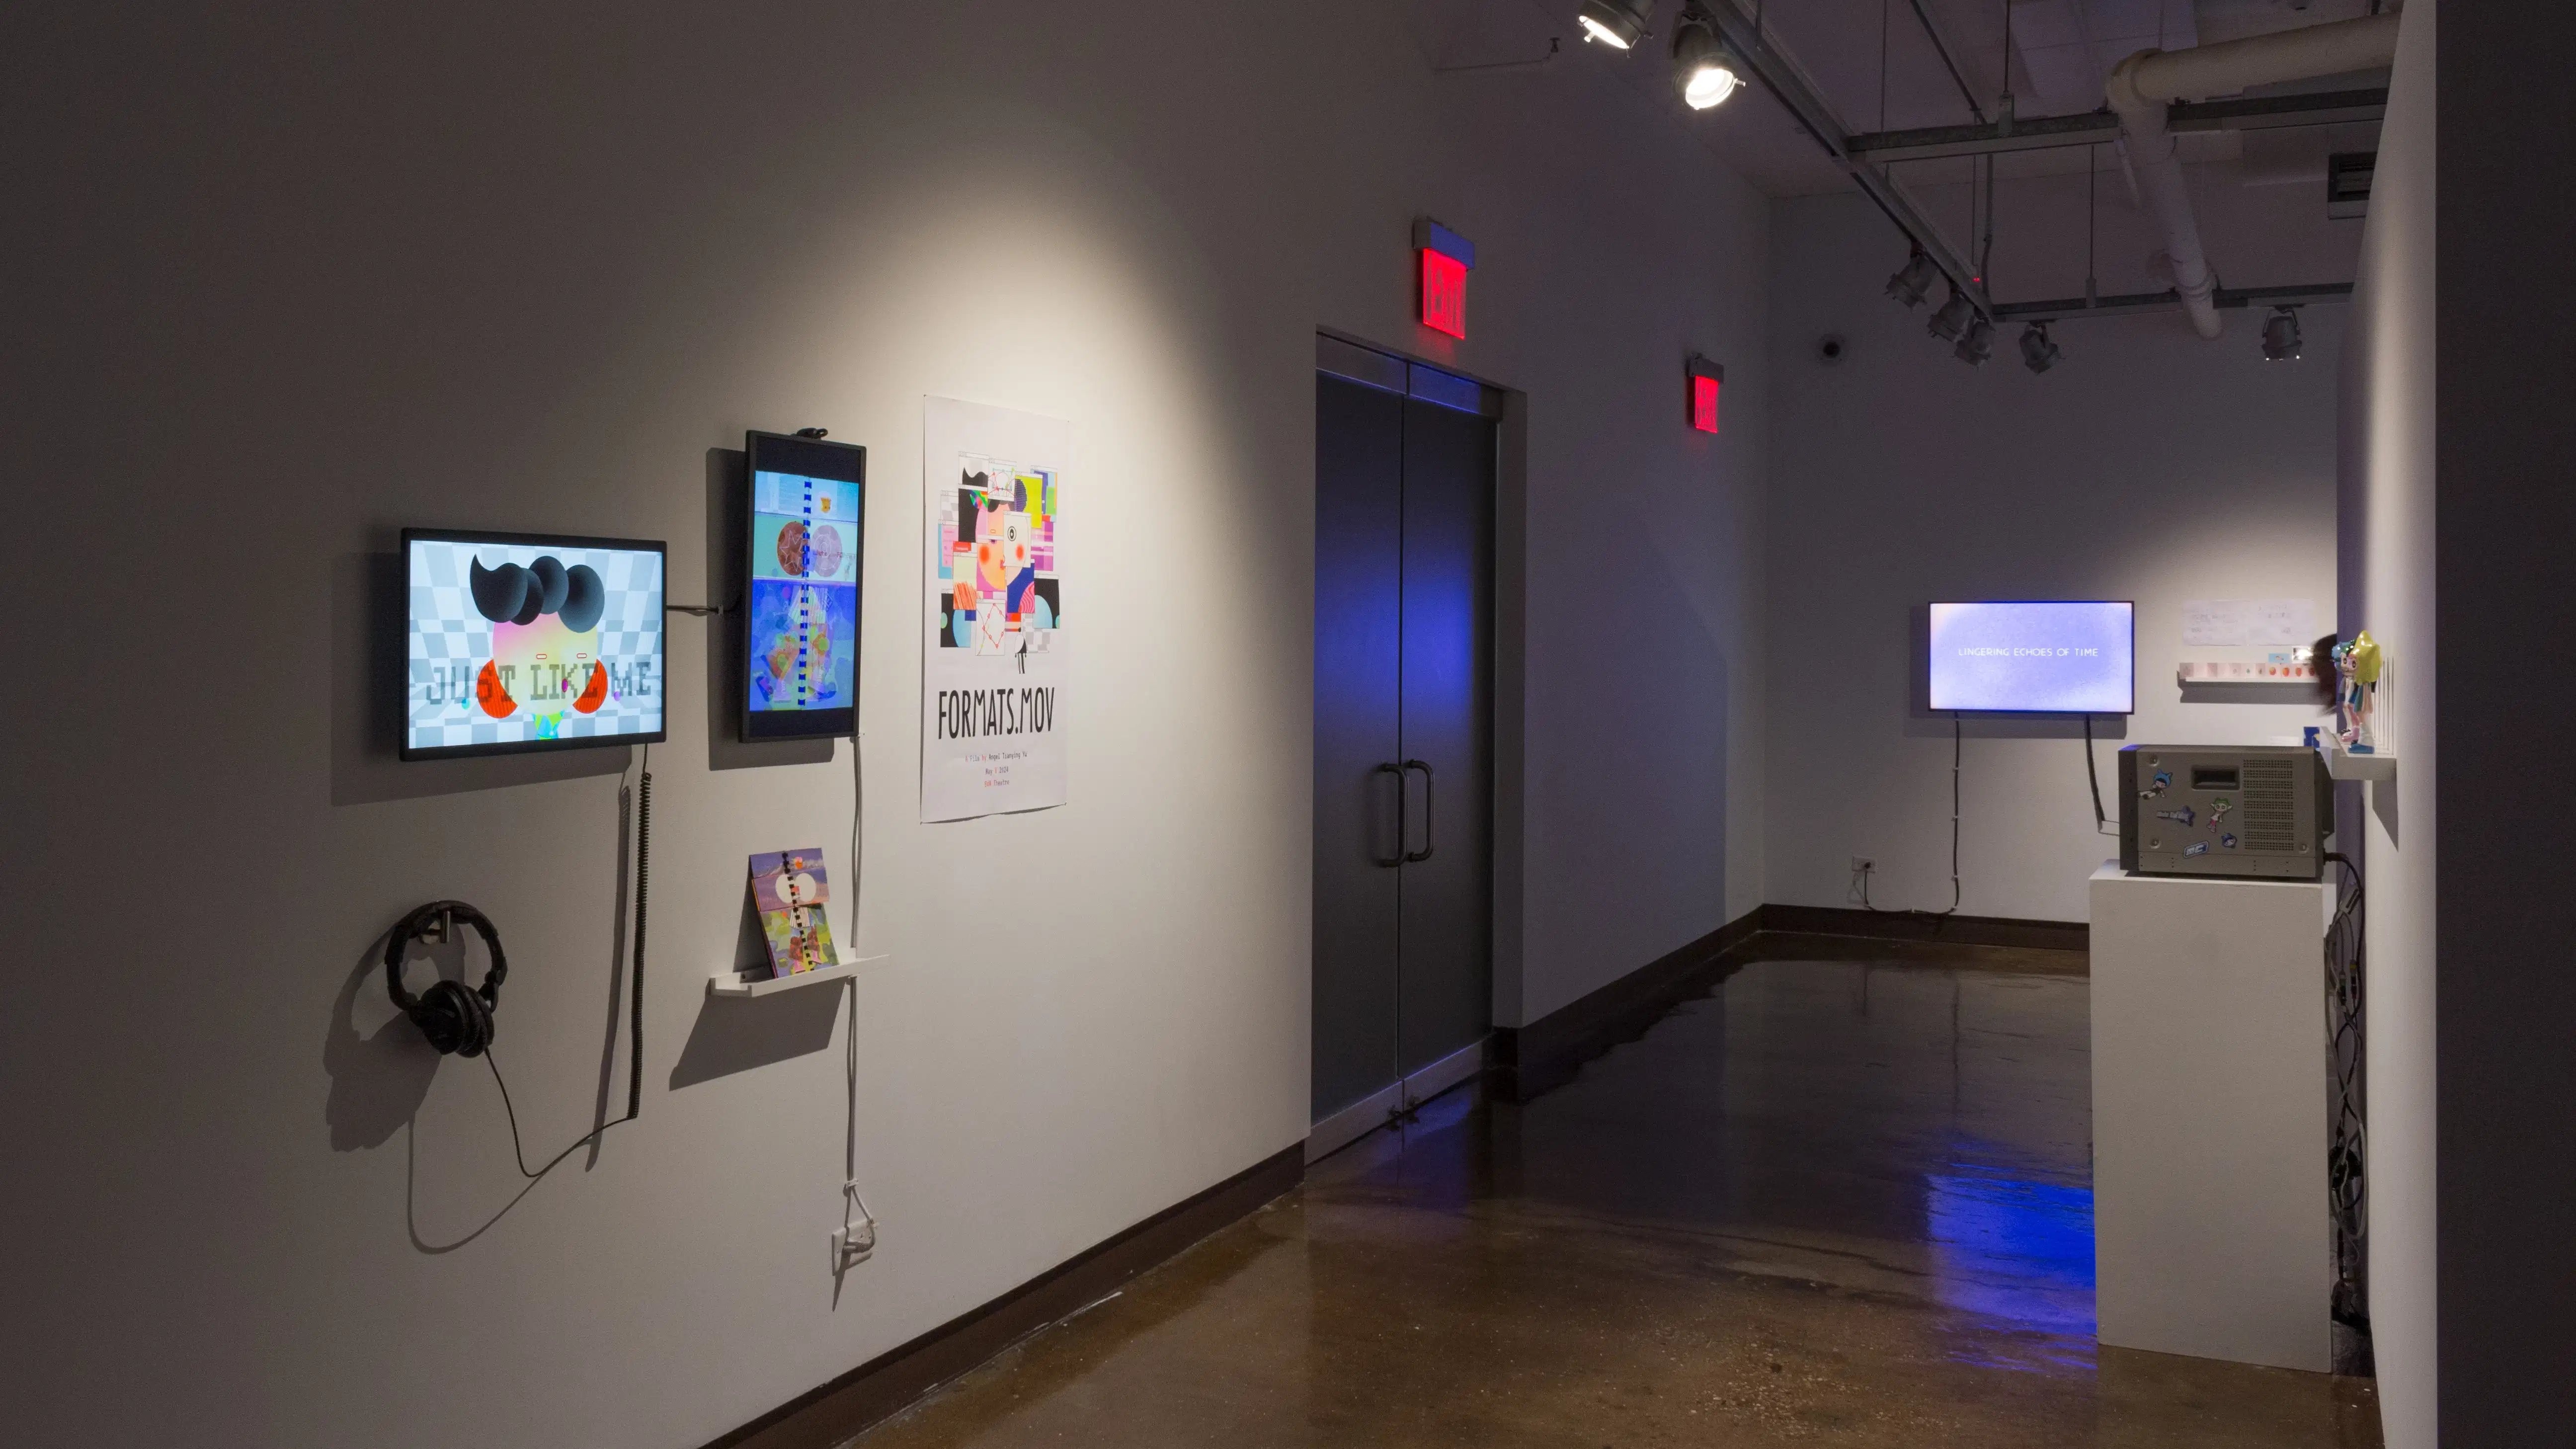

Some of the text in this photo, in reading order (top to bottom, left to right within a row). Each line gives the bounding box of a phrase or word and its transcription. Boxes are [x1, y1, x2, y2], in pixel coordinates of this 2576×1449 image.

[1958, 647, 2009, 656] LINGERING
[2014, 647, 2052, 656] ECHOES
[2075, 648, 2098, 656] TIME
[426, 661, 651, 705] JUST LIKE ME
[938, 687, 1054, 739] FORMATS.MOV
